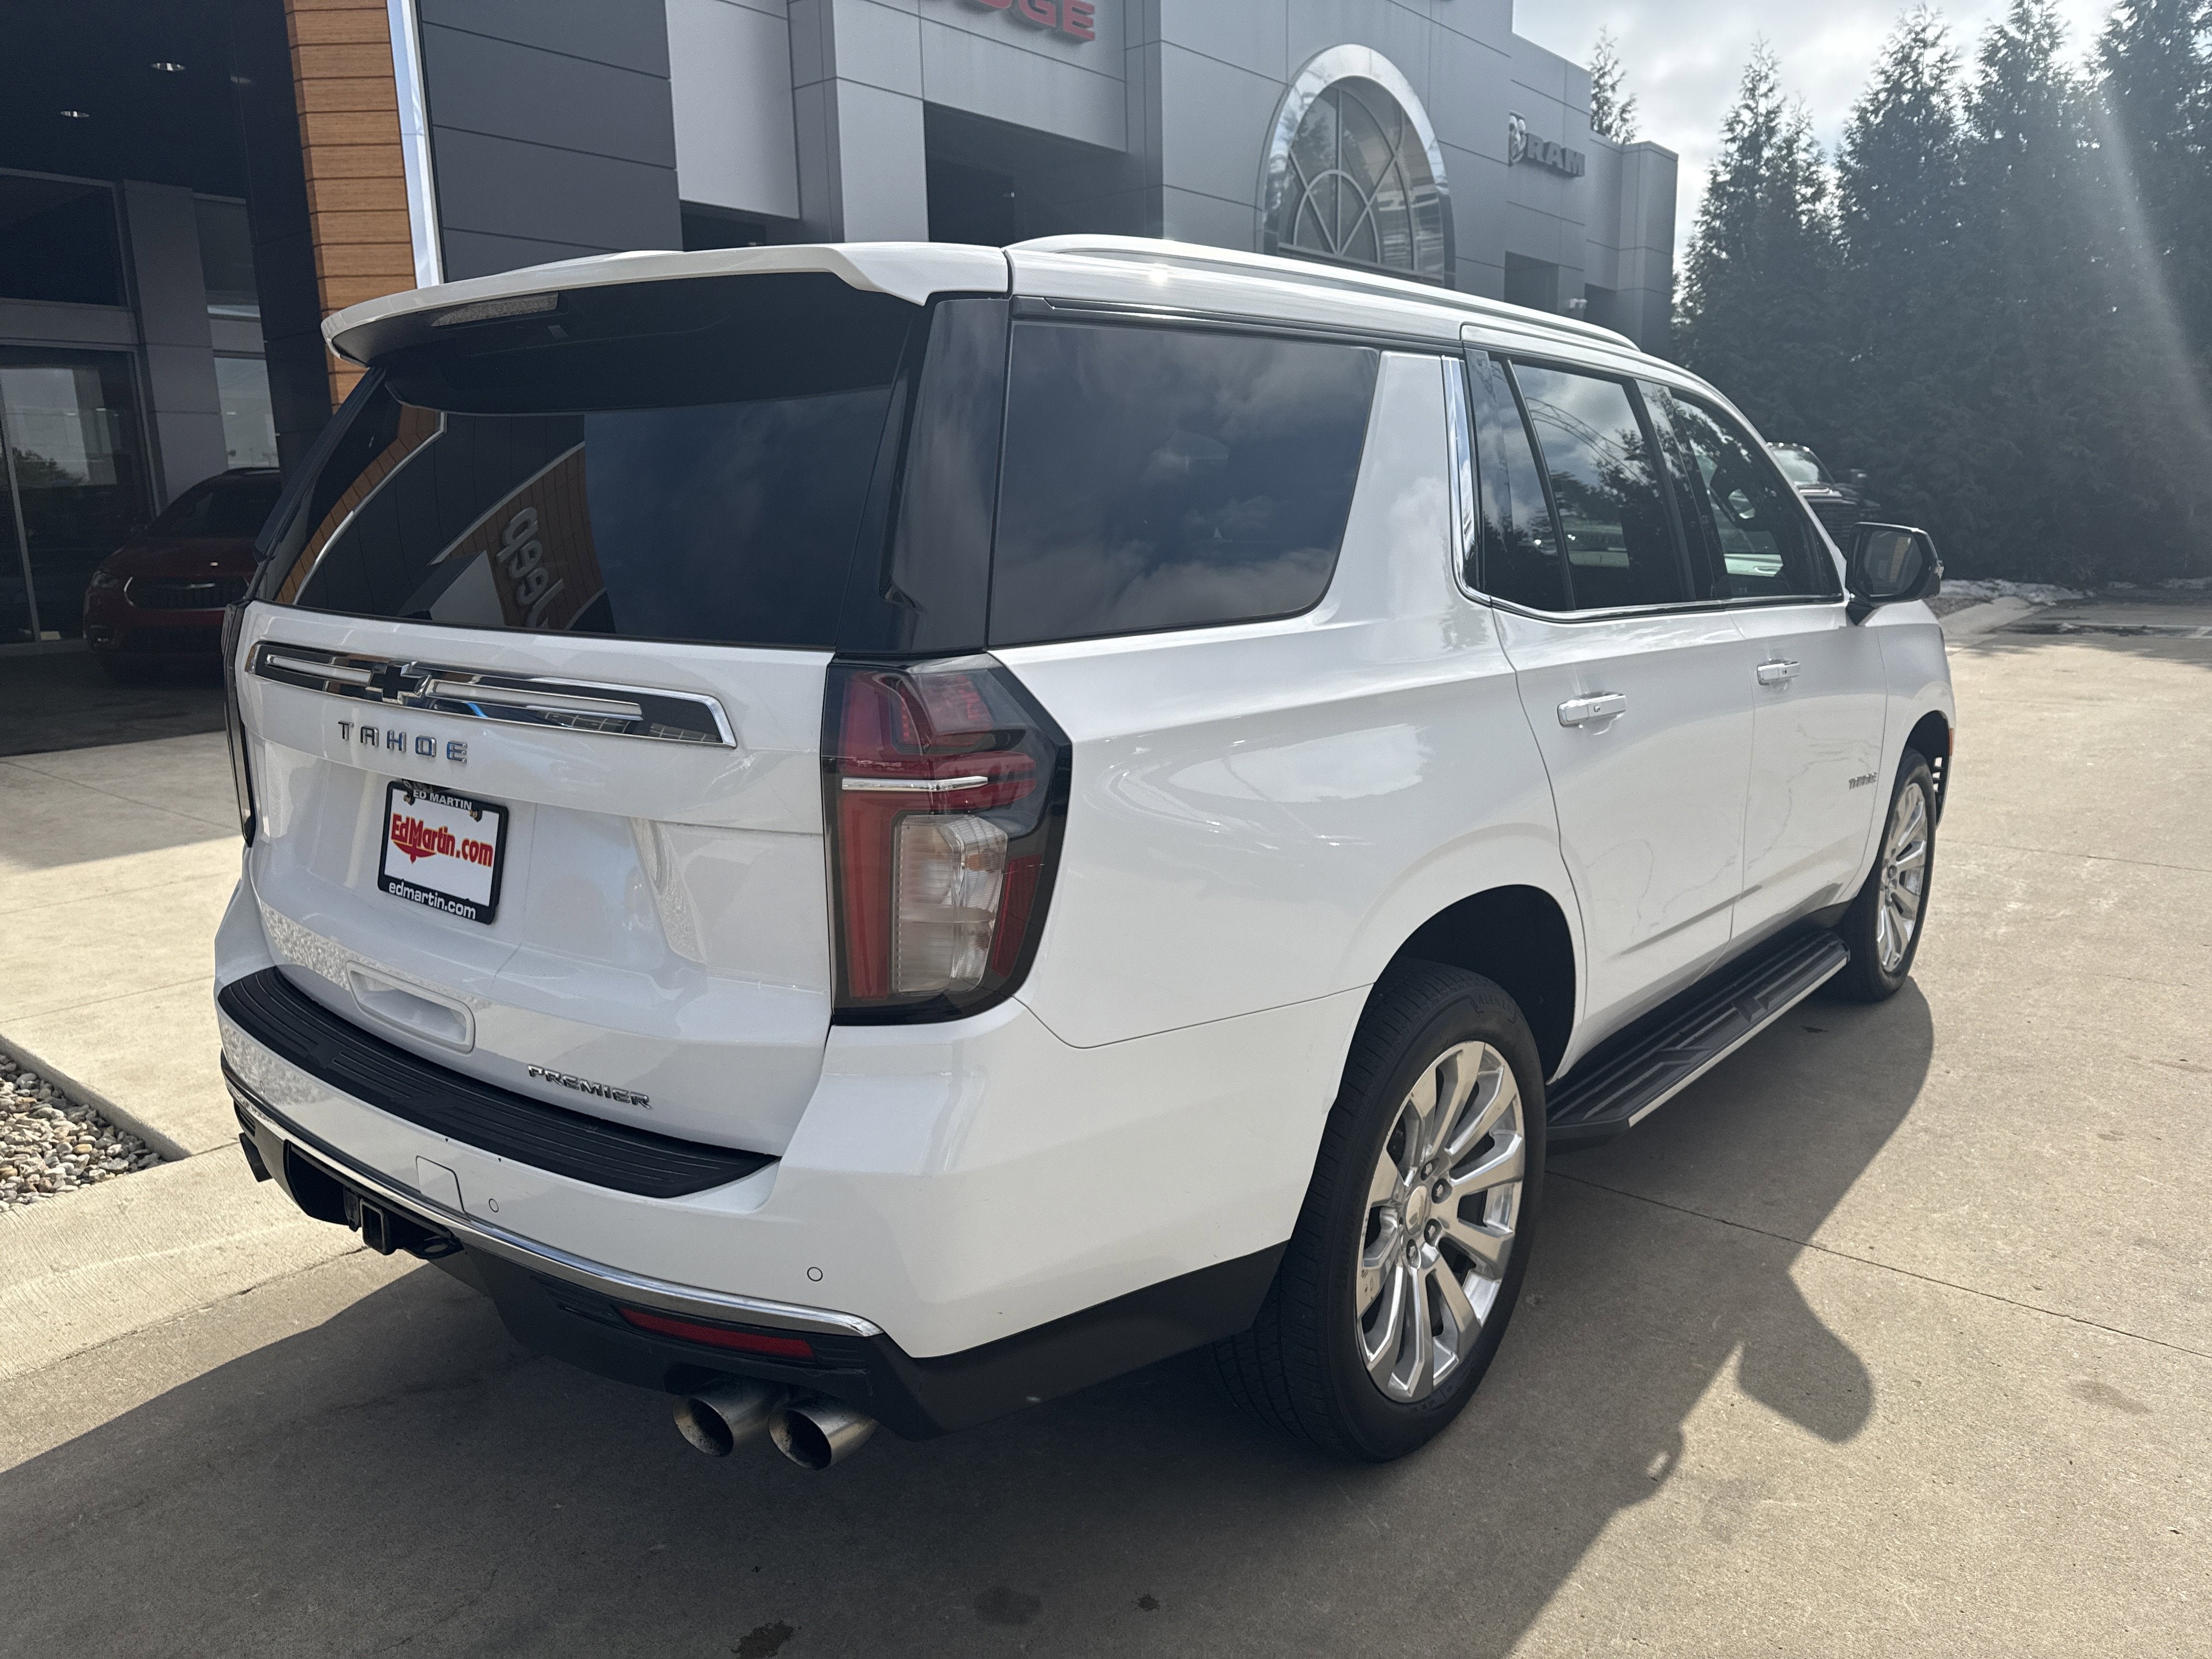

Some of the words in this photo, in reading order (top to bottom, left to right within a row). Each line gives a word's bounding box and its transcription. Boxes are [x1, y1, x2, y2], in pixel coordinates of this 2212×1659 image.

[978, 0, 1096, 41] GE
[1524, 133, 1585, 177] RAM
[338, 720, 467, 764] TAHOE
[413, 789, 427, 799] ED
[430, 793, 472, 810] MARTIN
[391, 813, 493, 867] EdMartin.com
[388, 882, 476, 919] edmartin.com
[528, 1064, 652, 1110] PREMIER
